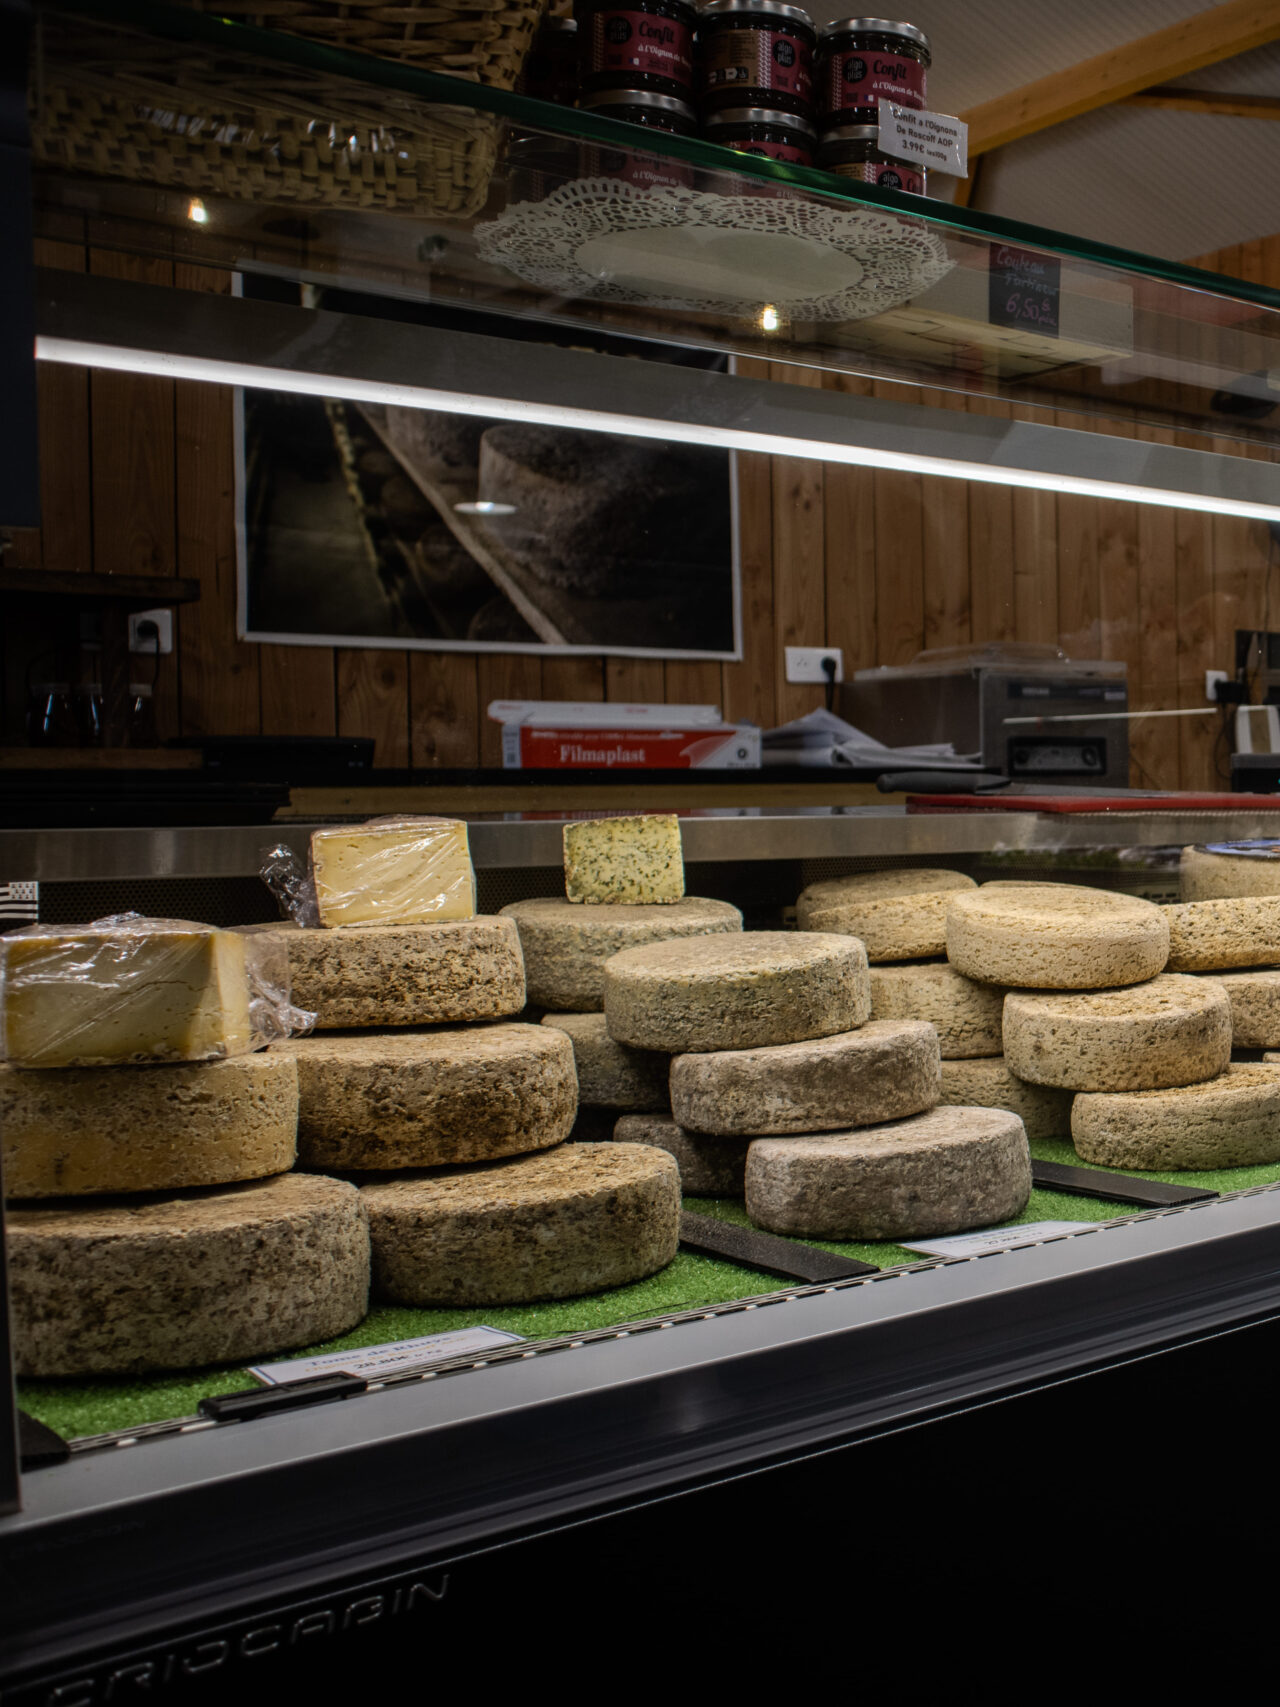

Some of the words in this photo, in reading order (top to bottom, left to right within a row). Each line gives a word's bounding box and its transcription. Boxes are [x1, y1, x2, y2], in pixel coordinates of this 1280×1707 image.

[639, 21, 675, 44] Confit
[777, 41, 793, 56] algo
[847, 58, 863, 71] algo
[873, 59, 907, 81] Confit
[847, 69, 863, 82] plus
[892, 108, 917, 125] Confit
[896, 124, 906, 135] De
[908, 128, 936, 144] Roscoff
[937, 137, 953, 149] AOP
[902, 139, 925, 154] 3.99€
[560, 744, 646, 765] Filmaplast
